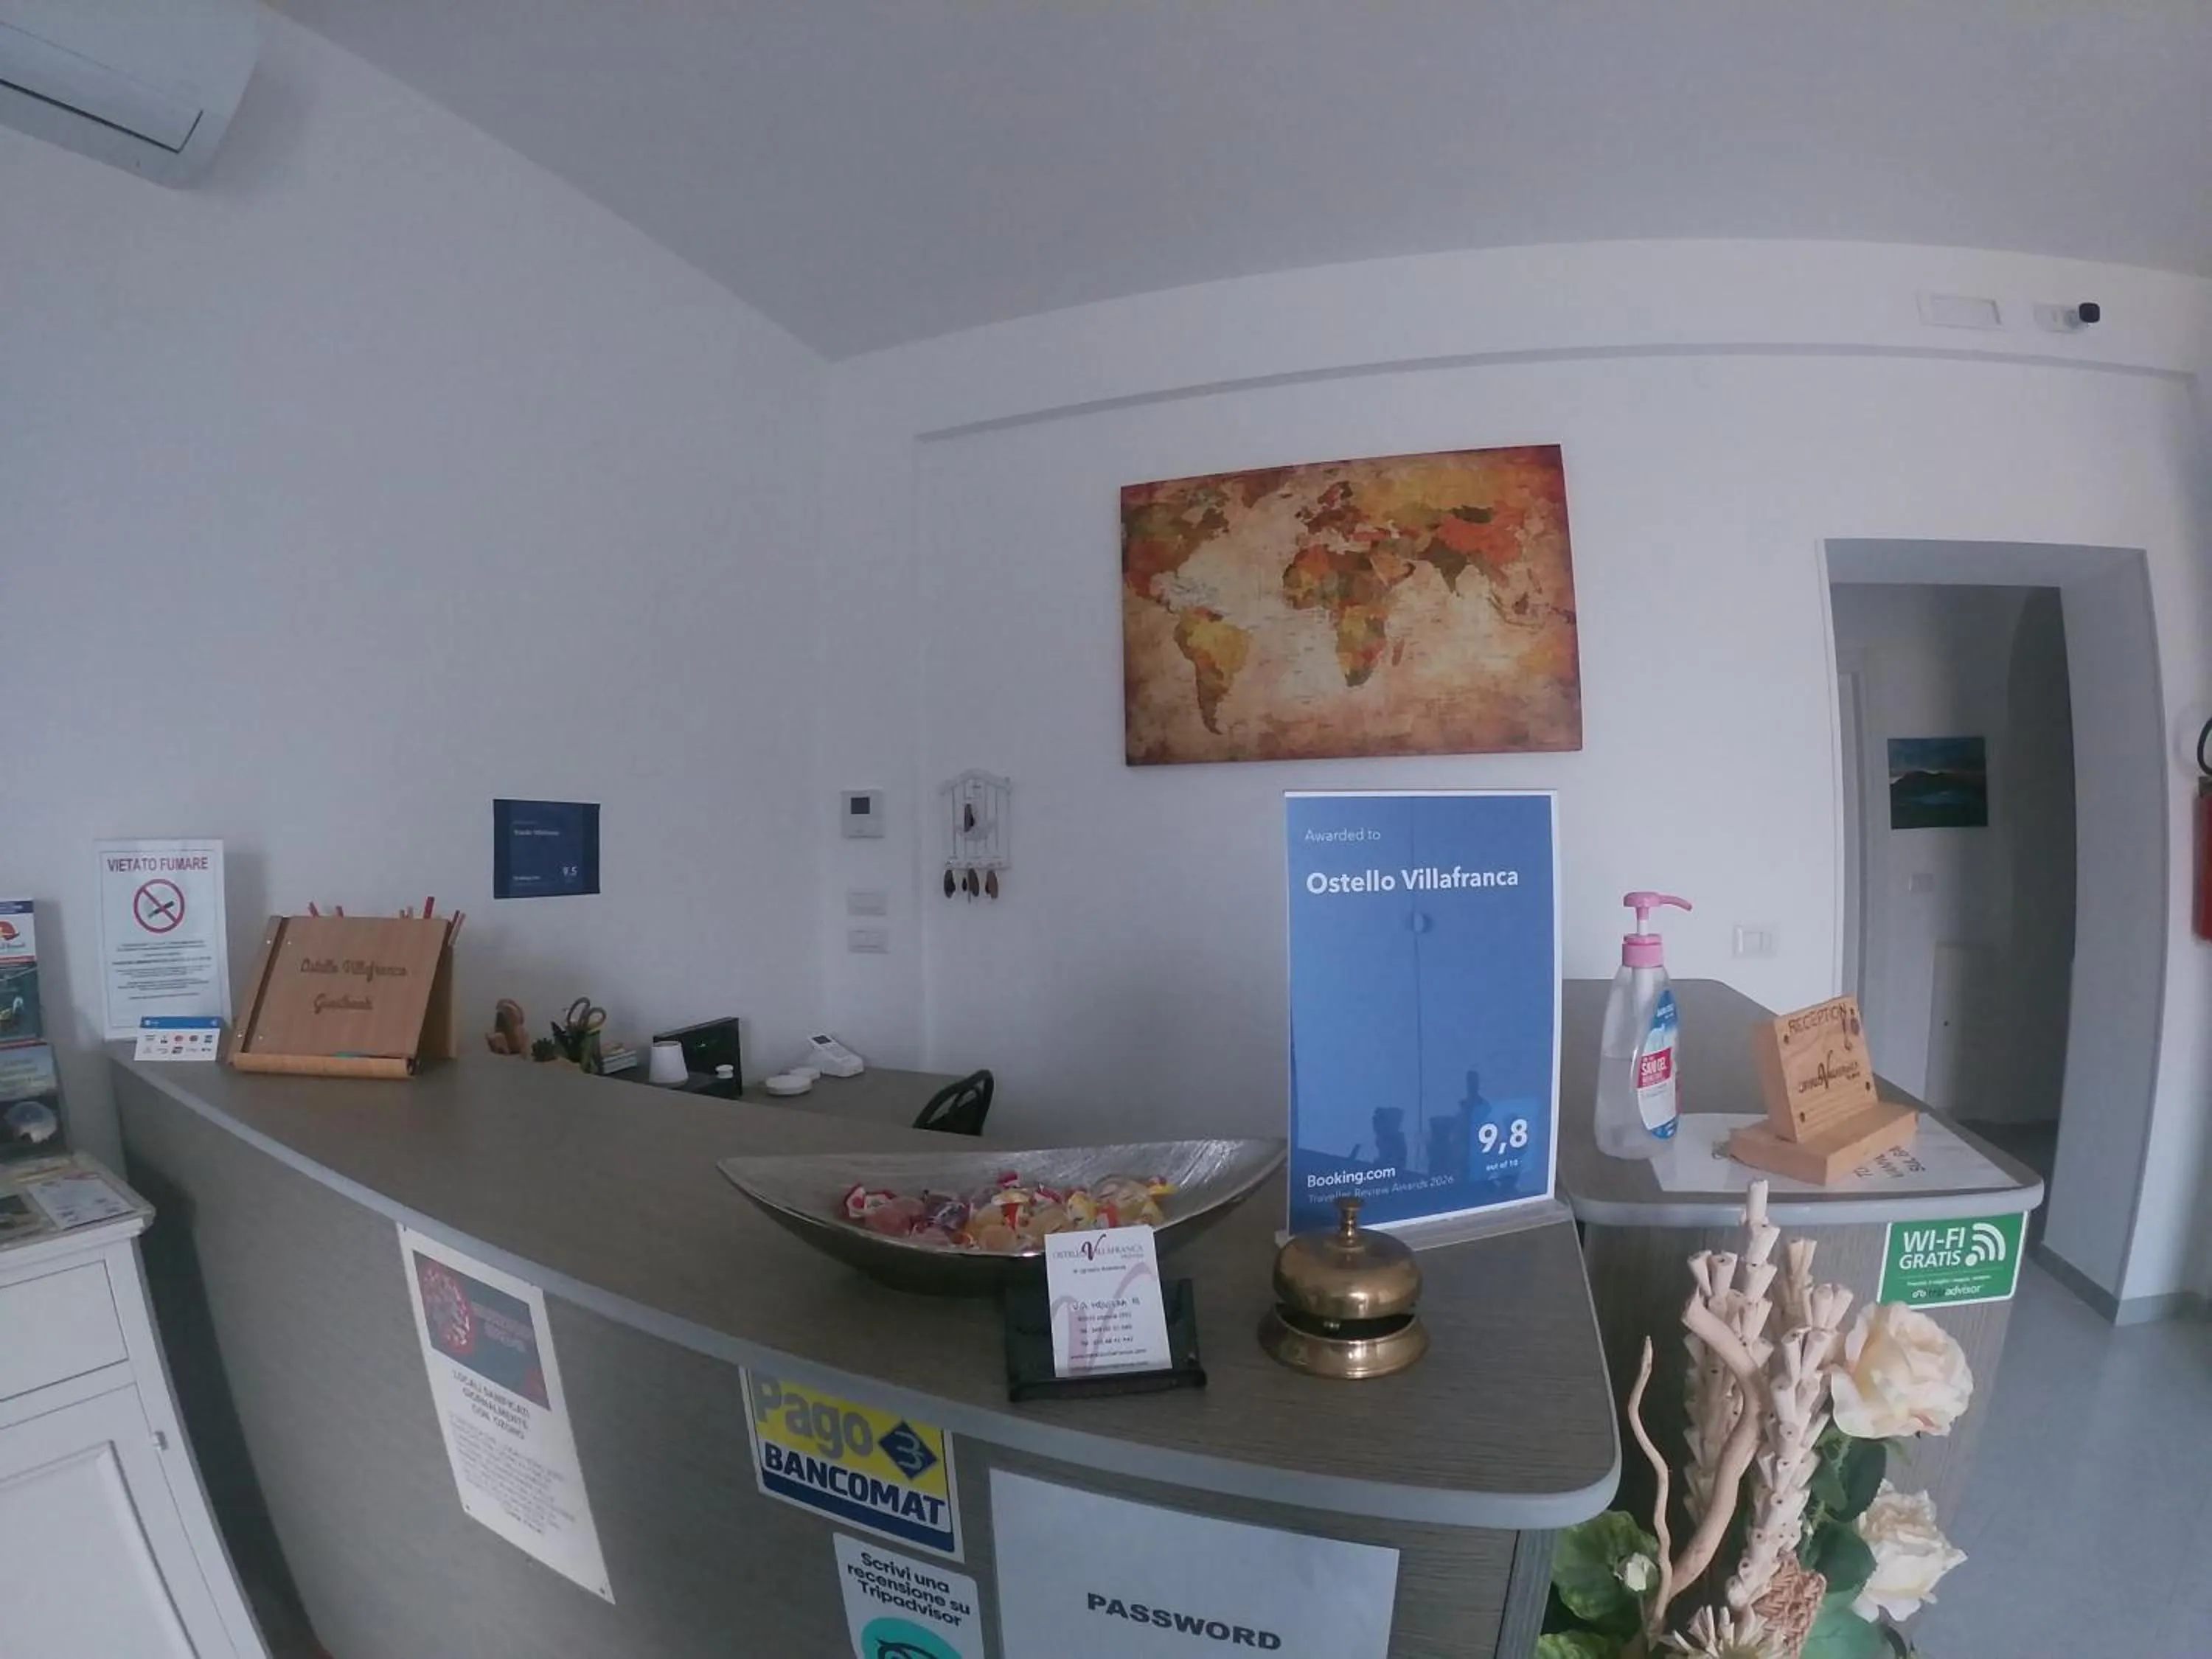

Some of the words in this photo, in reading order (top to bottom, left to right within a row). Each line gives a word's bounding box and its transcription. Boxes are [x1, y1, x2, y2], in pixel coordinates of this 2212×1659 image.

[1304, 828, 1364, 842] Awarded
[1367, 829, 1381, 841] to
[107, 858, 157, 872] VIETATO
[160, 856, 208, 871] FUMARE
[1306, 869, 1396, 894] Ostello
[1400, 865, 1519, 891] Villafranca
[1787, 1003, 1847, 1033] RECEPTION
[1478, 1118, 1528, 1155] 9,8
[1307, 1166, 1397, 1189] Booking.com
[1486, 1162, 1498, 1172] out
[1499, 1160, 1508, 1170] of
[1354, 1186, 1389, 1199] Review
[1391, 1180, 1429, 1193] Awards
[1903, 1226, 1966, 1253] WI-FI
[1899, 1250, 1961, 1270] GRATIS
[752, 1377, 874, 1459] Pago
[764, 1441, 945, 1525] BANCOMAT
[861, 1551, 911, 1581] Scrivi
[914, 1572, 950, 1593] una
[847, 1563, 946, 1607] recensione
[949, 1599, 970, 1615] su
[858, 1579, 962, 1627] Tripadvisor
[1087, 1592, 1281, 1650] PASSWORD
